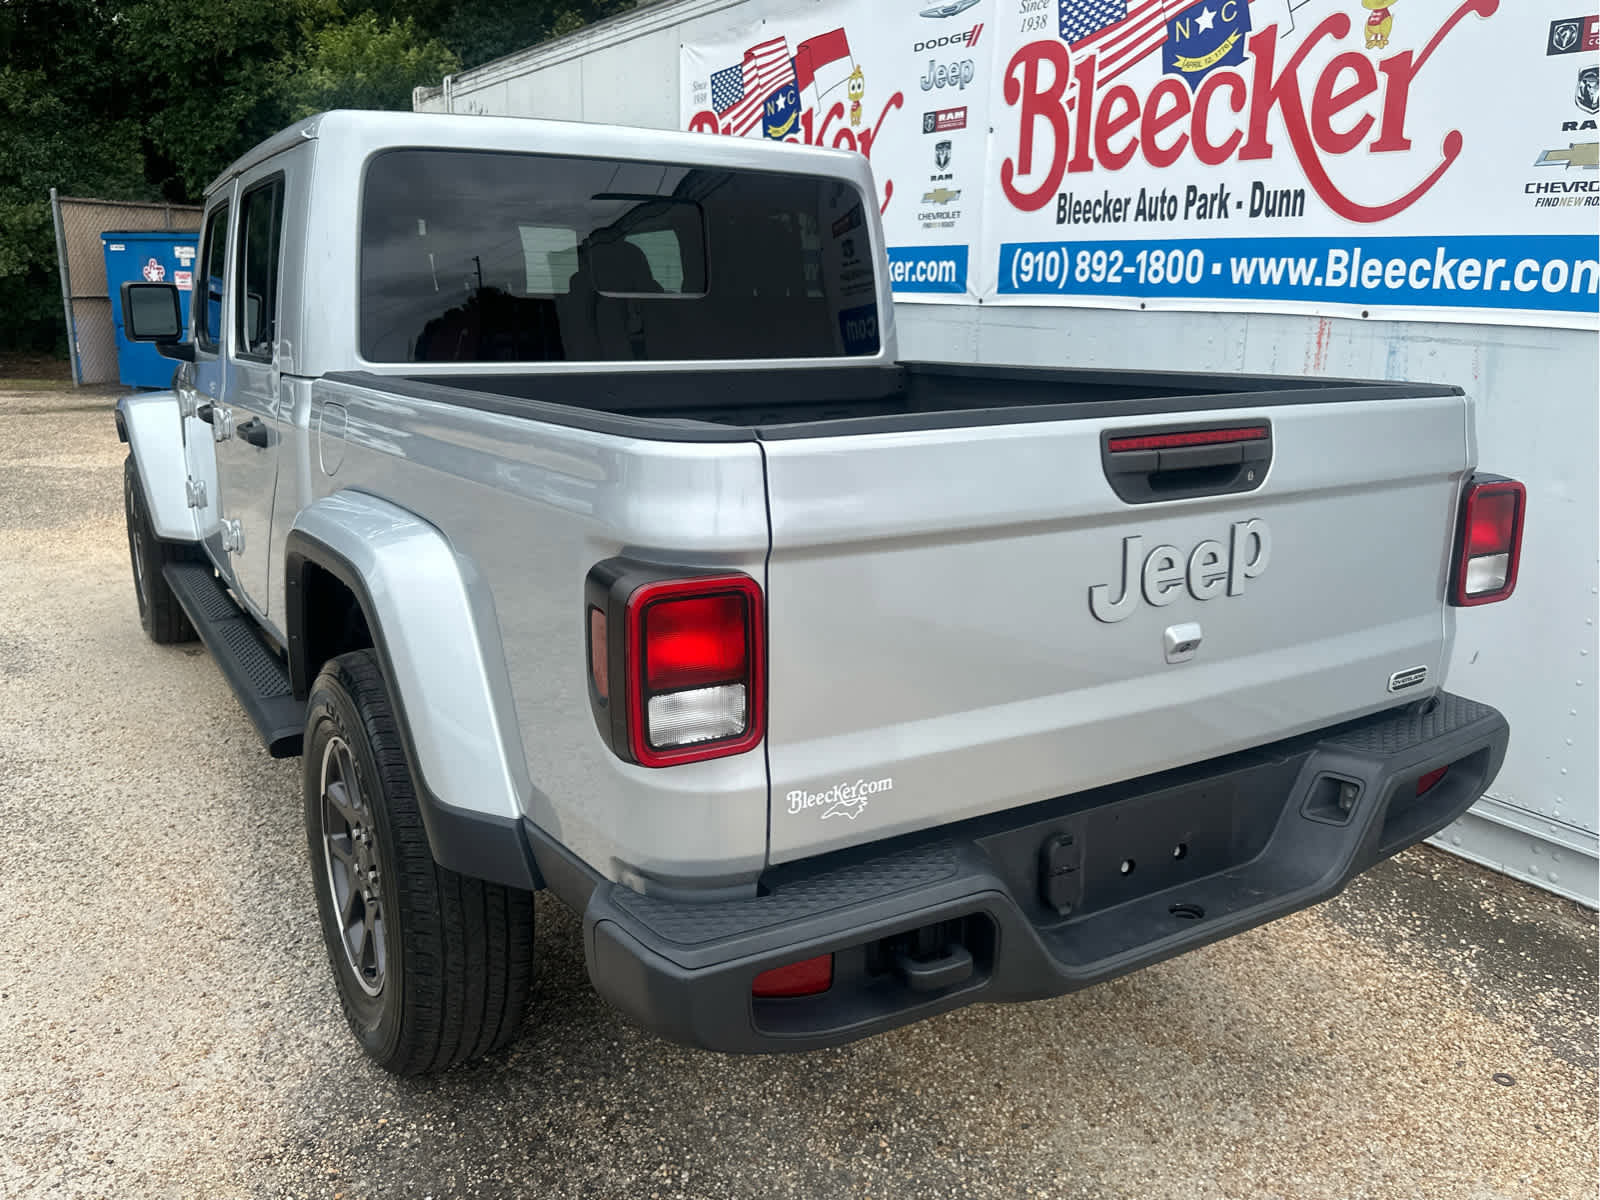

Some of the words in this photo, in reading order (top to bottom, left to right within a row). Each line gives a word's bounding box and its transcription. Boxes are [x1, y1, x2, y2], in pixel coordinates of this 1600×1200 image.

[1019, 0, 1048, 14] Since
[1021, 14, 1048, 33] 1938
[1176, 18, 1190, 42] N
[1221, 1, 1238, 22] C
[913, 30, 973, 53] DODGE
[920, 59, 975, 91] Jeep
[937, 110, 965, 122] RAM
[930, 173, 953, 182] RAM
[1056, 191, 1131, 225] Bleecker
[1134, 187, 1178, 222] Auto
[1183, 183, 1231, 220] Park
[1249, 180, 1306, 218] Dunn
[1011, 247, 1069, 289] (910)
[1074, 249, 1204, 284] 892-1800
[1088, 517, 1272, 624] Jeep
